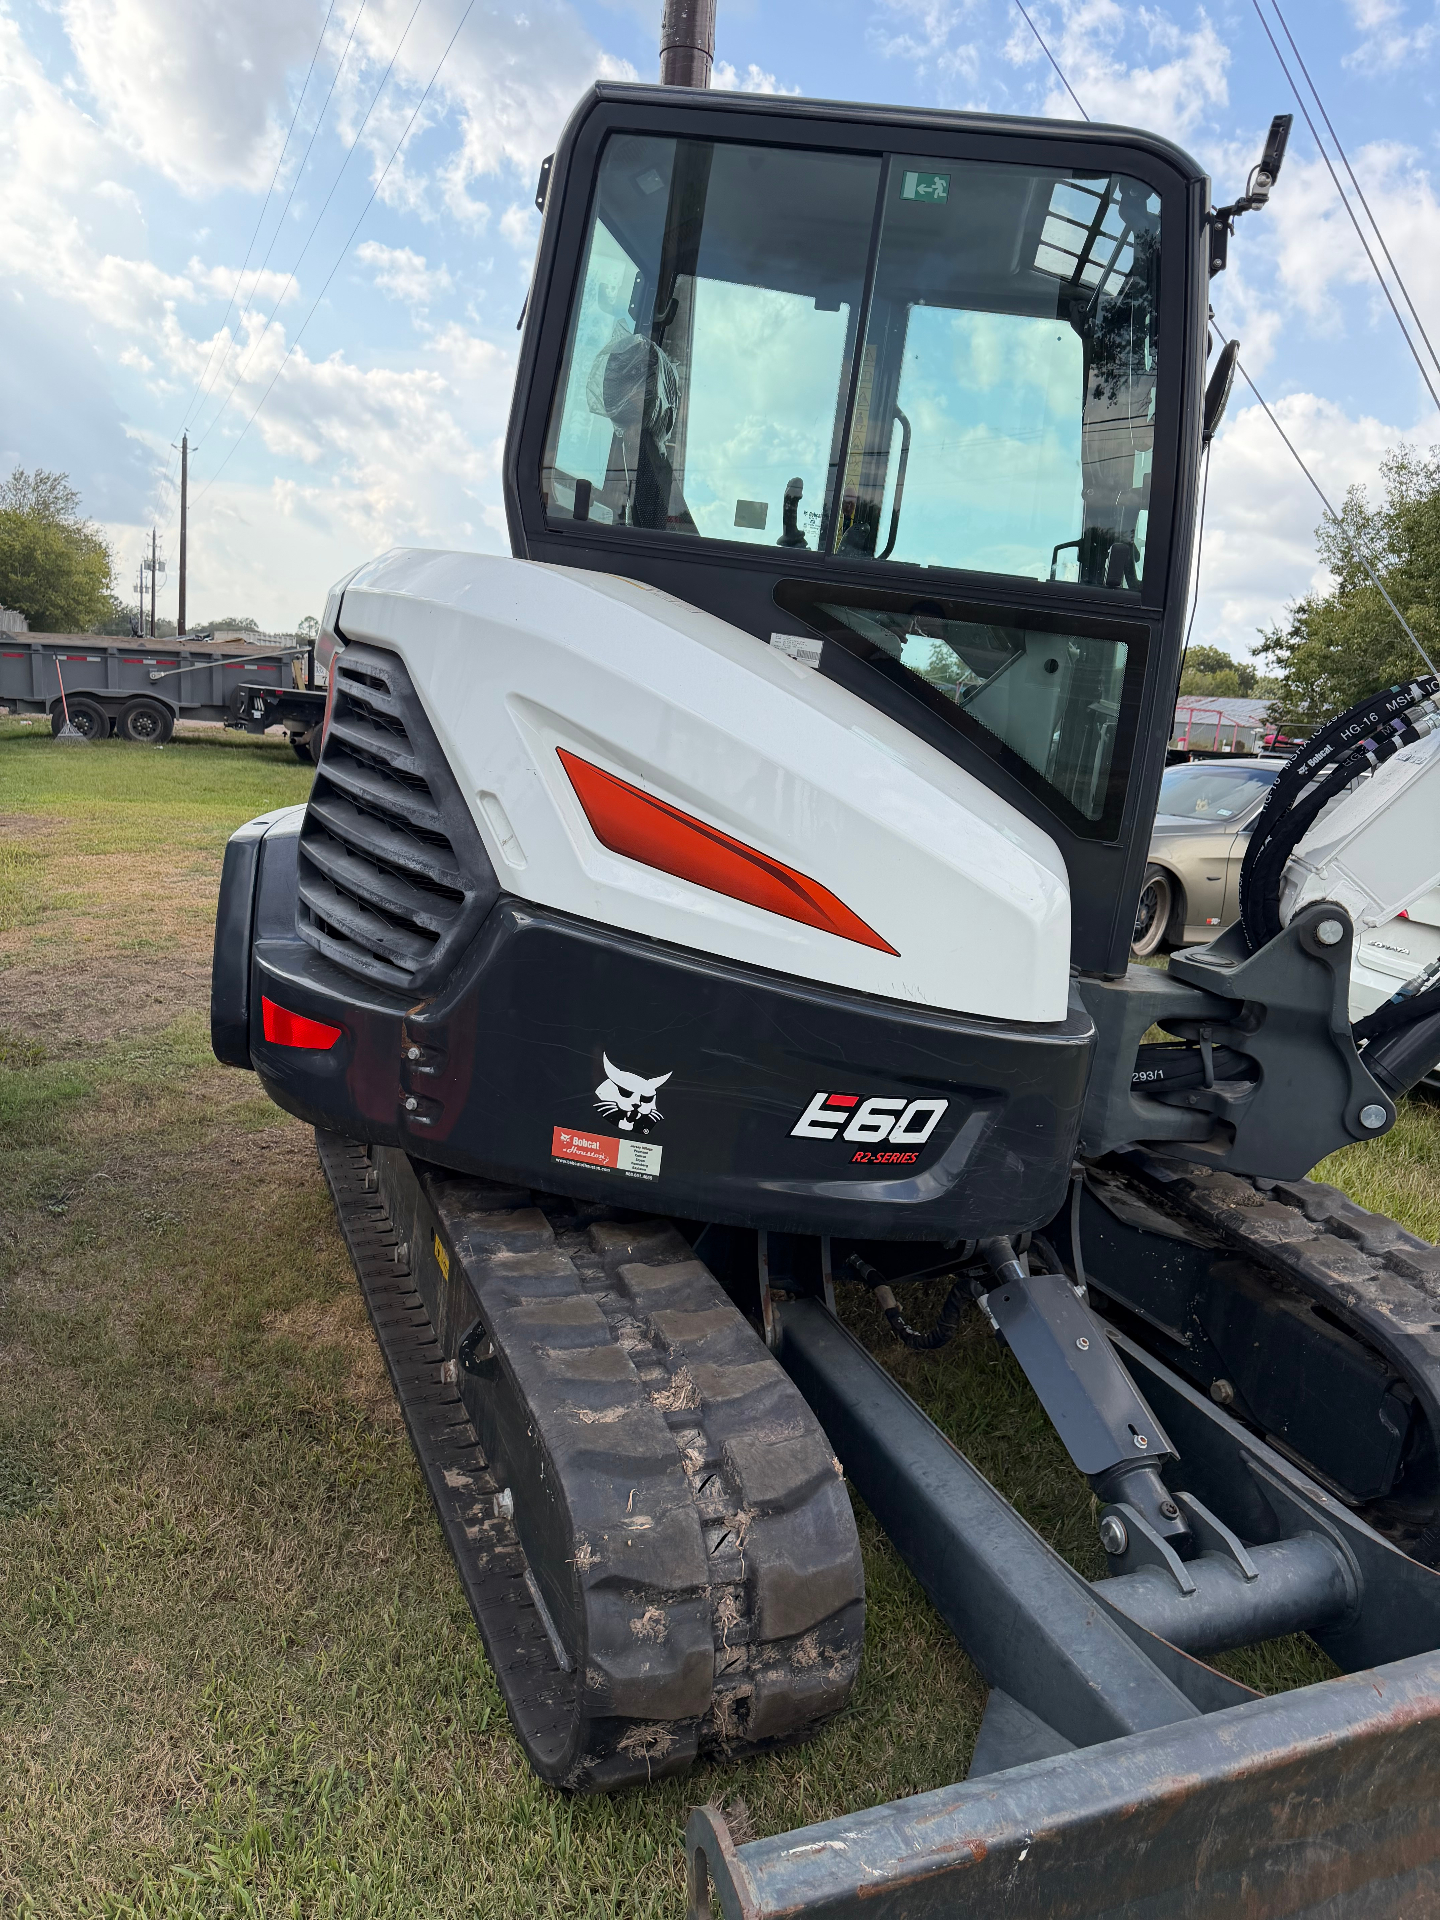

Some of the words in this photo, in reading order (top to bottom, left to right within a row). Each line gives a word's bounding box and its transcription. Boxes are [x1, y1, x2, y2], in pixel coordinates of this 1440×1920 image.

[1340, 712, 1379, 741] HG-16
[1307, 744, 1334, 768] Bobcat
[1132, 1070, 1164, 1082] 293/1
[790, 1092, 949, 1144] E60
[573, 1137, 600, 1150] Bobcat
[851, 1151, 920, 1164] R2-SERIES
